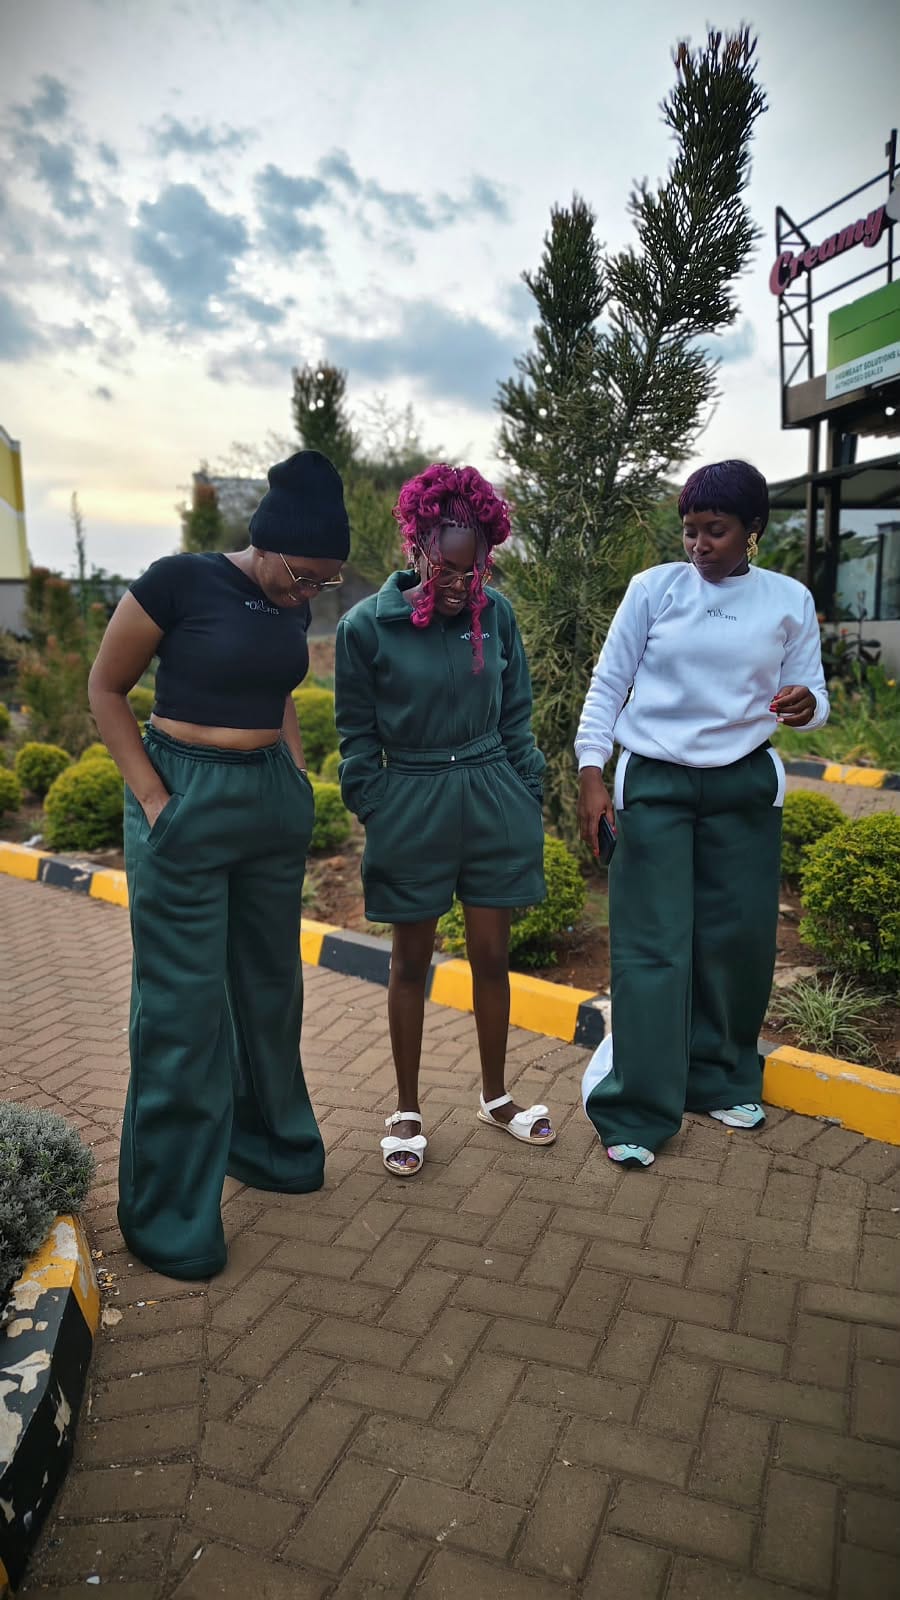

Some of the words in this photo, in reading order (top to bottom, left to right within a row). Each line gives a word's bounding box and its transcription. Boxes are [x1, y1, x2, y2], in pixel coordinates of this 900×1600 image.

[769, 204, 886, 296] Creamy
[864, 350, 896, 370] SOLUTIONS
[864, 366, 883, 379] DEALER
